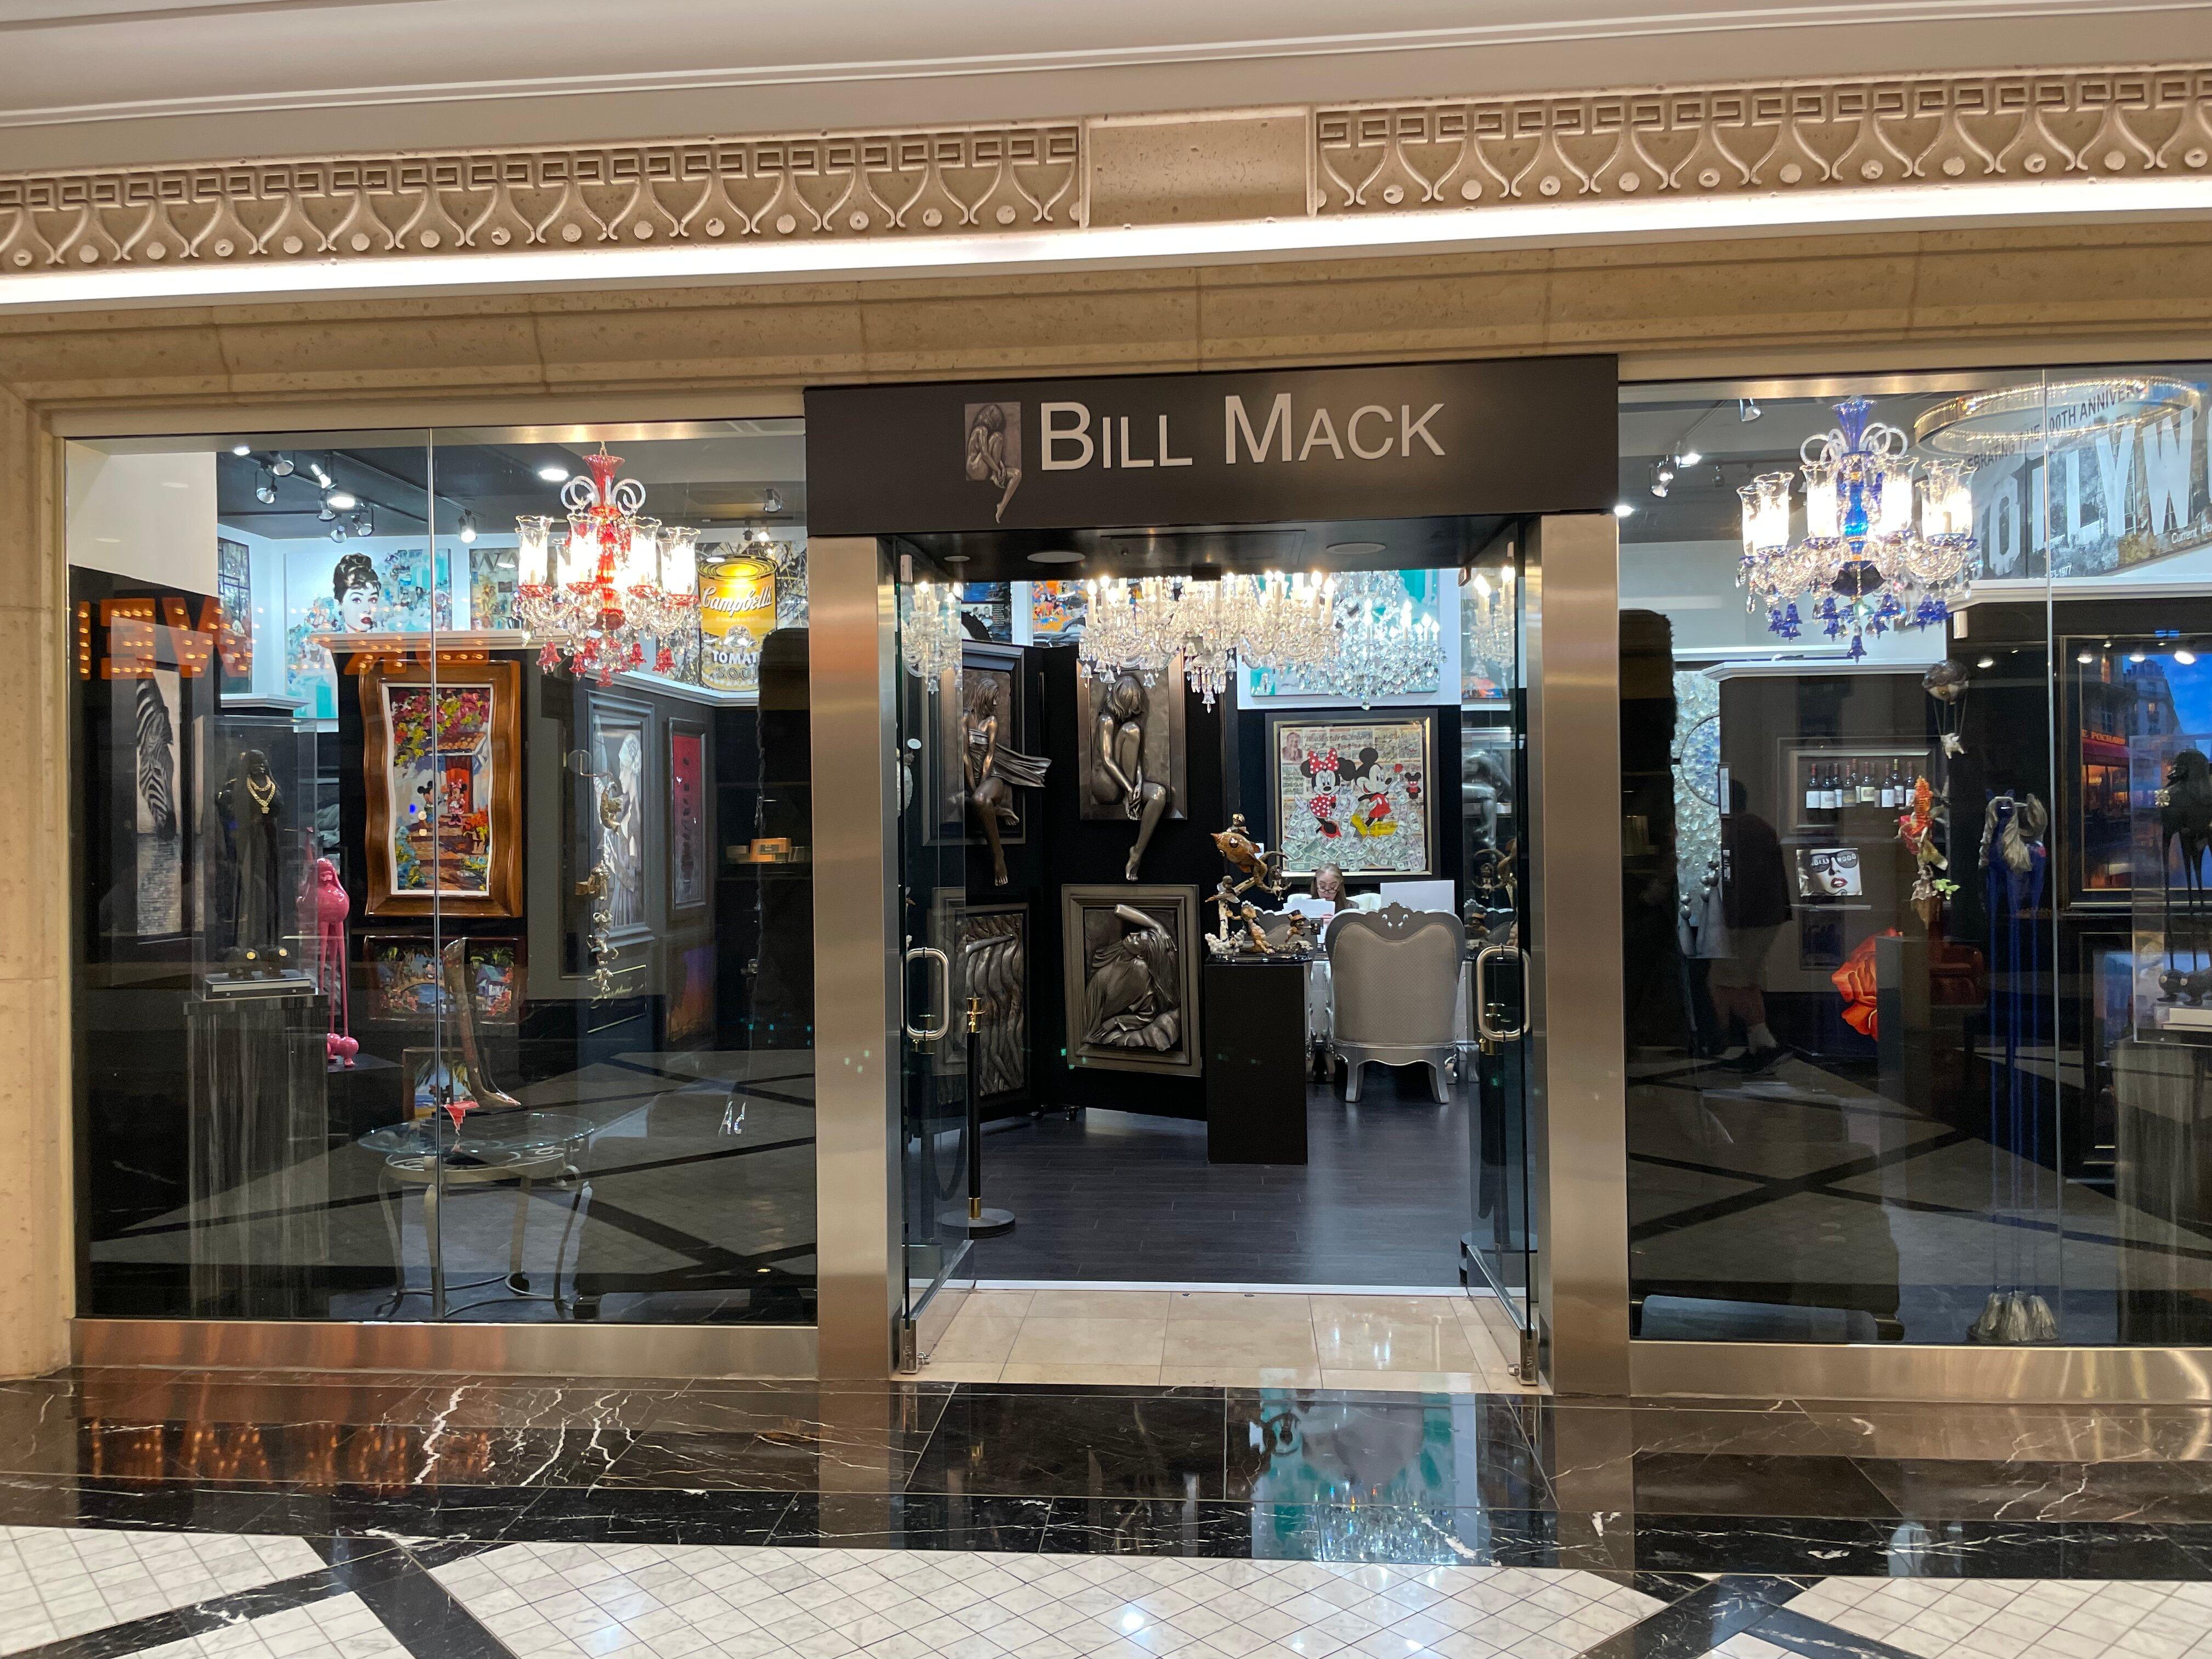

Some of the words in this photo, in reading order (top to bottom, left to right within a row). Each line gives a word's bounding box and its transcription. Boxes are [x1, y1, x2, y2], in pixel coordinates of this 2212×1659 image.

[1041, 400, 1193, 471] BILL
[1224, 392, 1447, 465] MACK
[2047, 405, 2076, 432] 00TH
[712, 650, 759, 664] TOMAT
